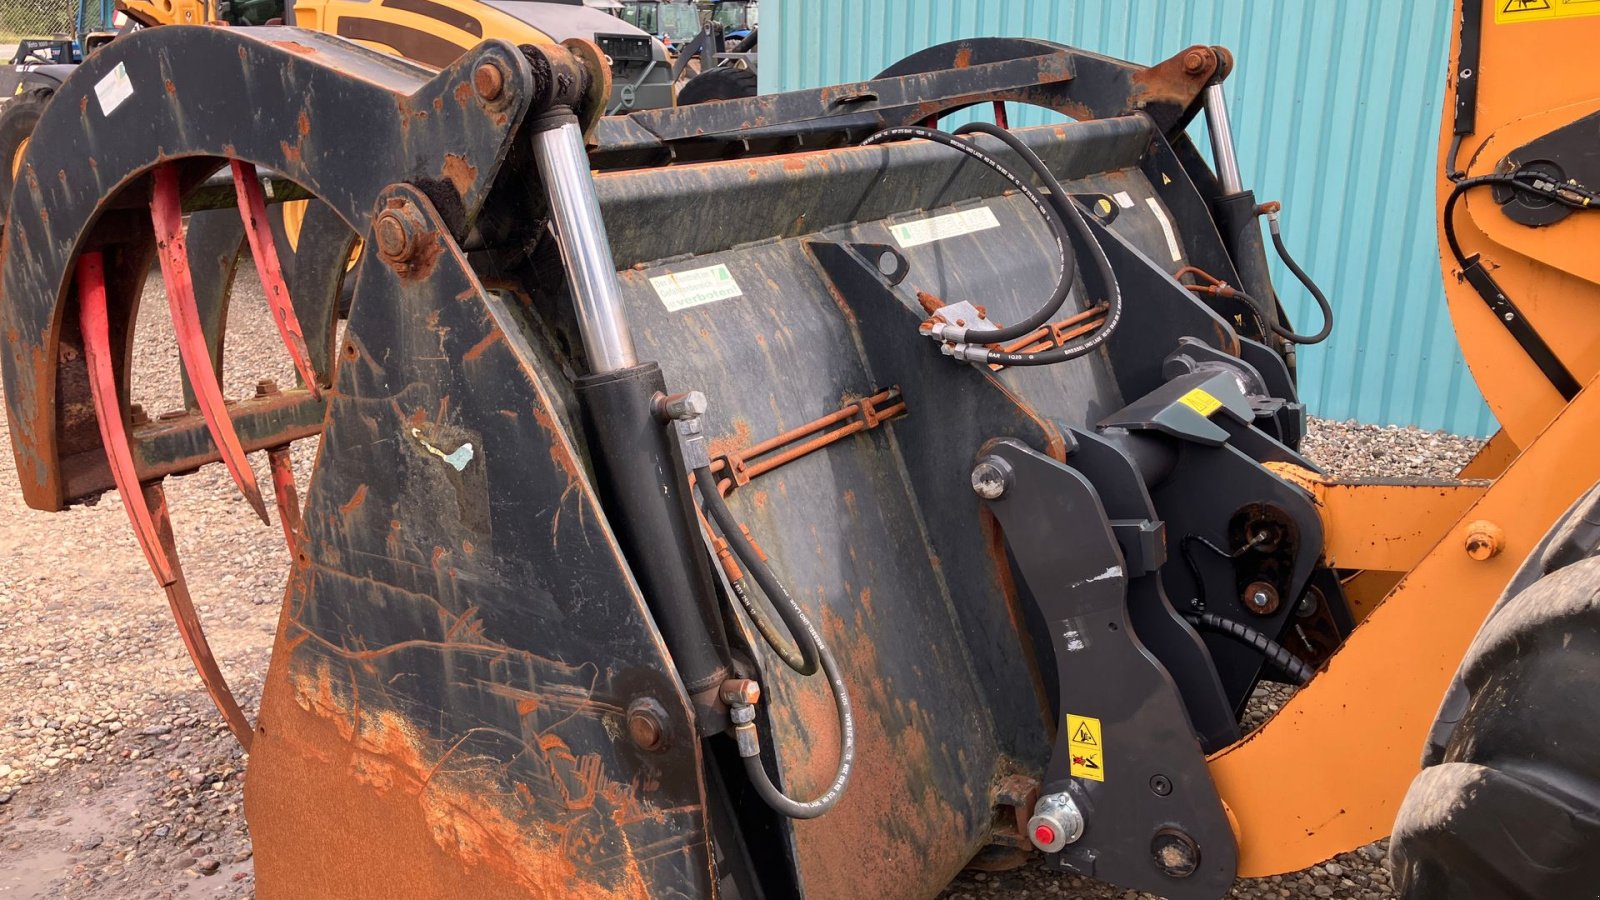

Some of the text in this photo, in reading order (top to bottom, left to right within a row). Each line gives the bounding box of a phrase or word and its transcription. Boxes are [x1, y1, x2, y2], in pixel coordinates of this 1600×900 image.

[676, 284, 739, 305] verboten!
[800, 613, 810, 625] UND
[809, 624, 825, 649] BRESSEL
